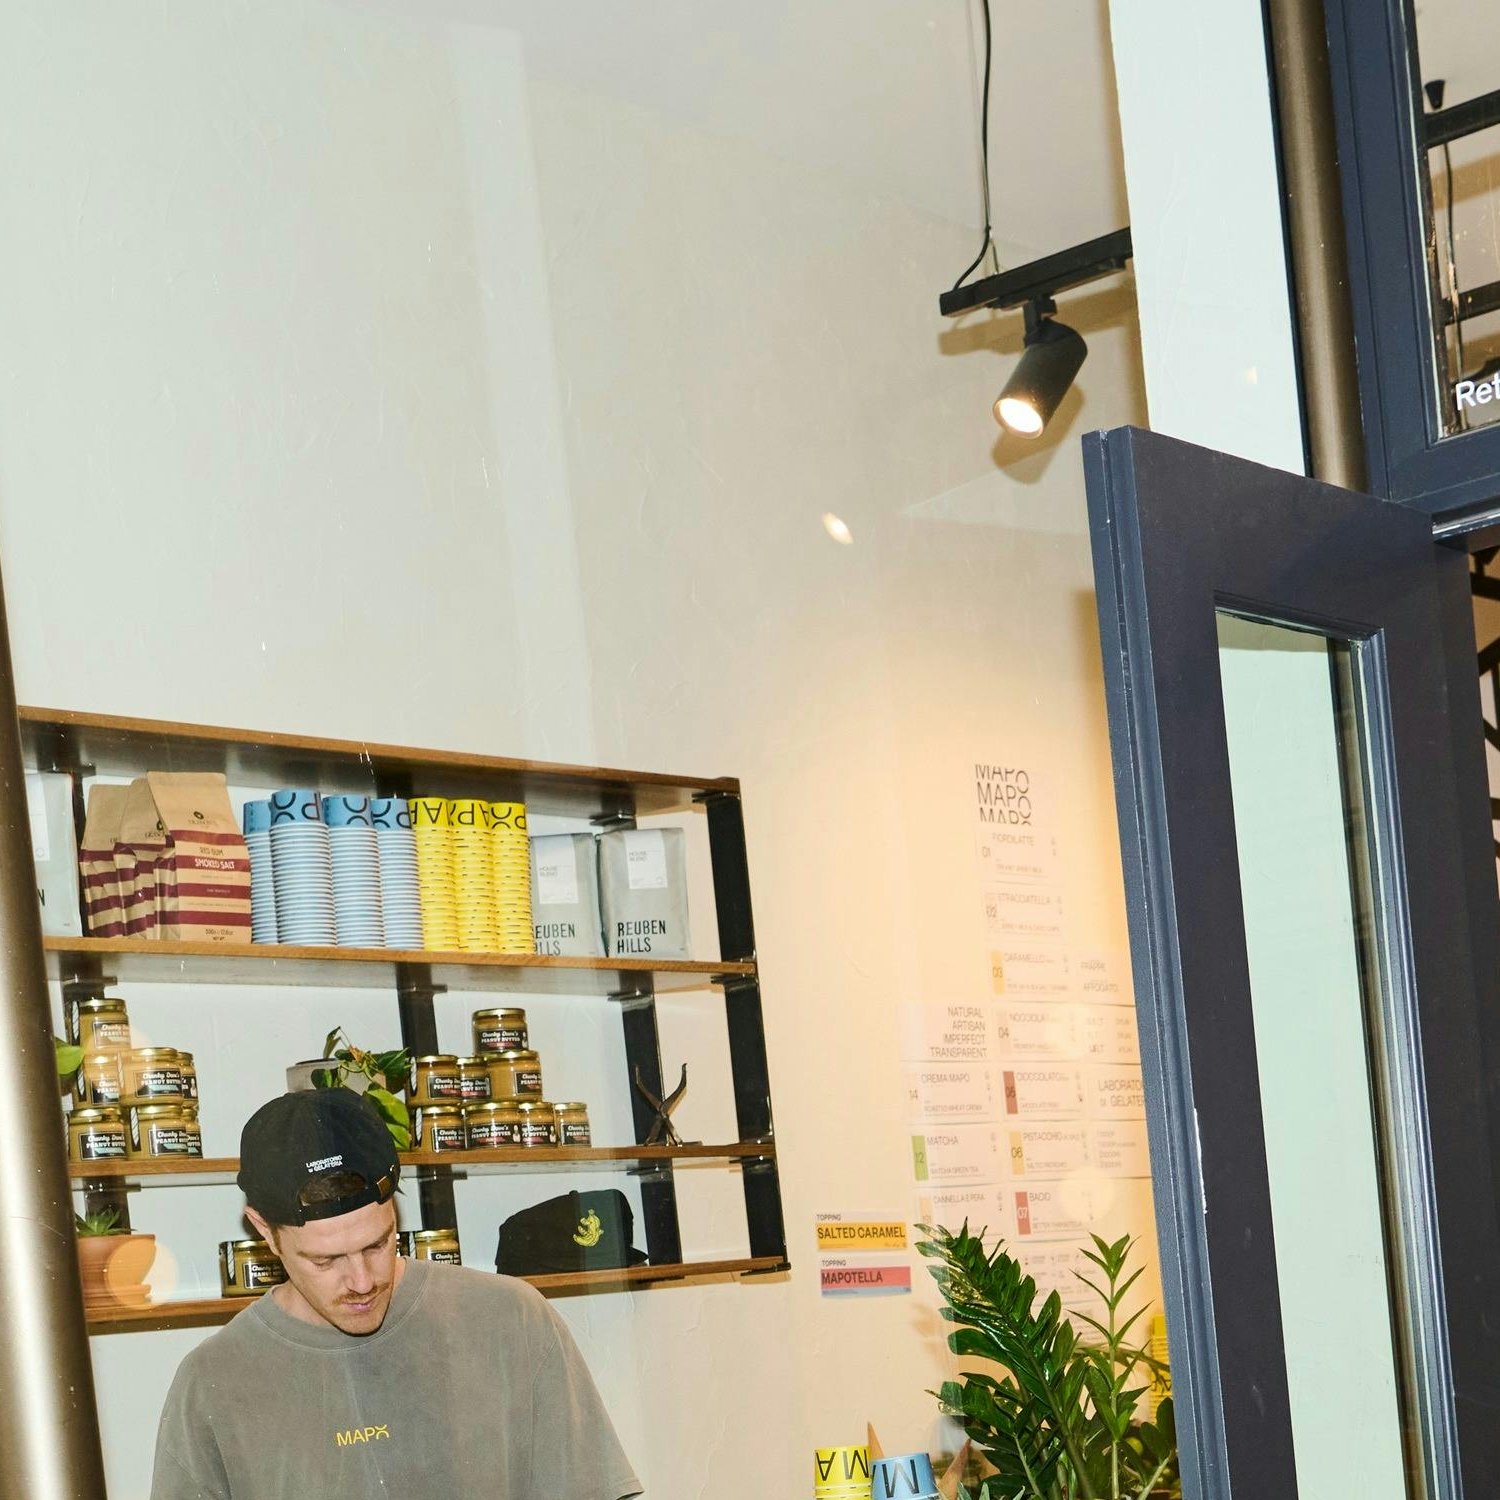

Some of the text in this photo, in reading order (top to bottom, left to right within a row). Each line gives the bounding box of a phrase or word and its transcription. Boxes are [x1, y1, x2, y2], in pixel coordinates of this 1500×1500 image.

[977, 781, 1032, 819] MAPO
[194, 857, 236, 870] SMOKED SALT
[617, 919, 667, 938] REUBEN
[616, 937, 652, 954] HILLS
[947, 1006, 985, 1018] NATURAL
[951, 1019, 986, 1031] ARTISAN
[942, 1033, 986, 1045] IMPERFECT
[929, 1046, 988, 1059] TRANSPARENT
[926, 1135, 960, 1146] MATCHA
[816, 1213, 842, 1222] TOPPING
[1017, 1207, 1029, 1220] 07
[817, 1226, 906, 1240] SALTED CARAMEL
[821, 1259, 847, 1267] TOPPING
[821, 1270, 884, 1285] MAPOTELLA
